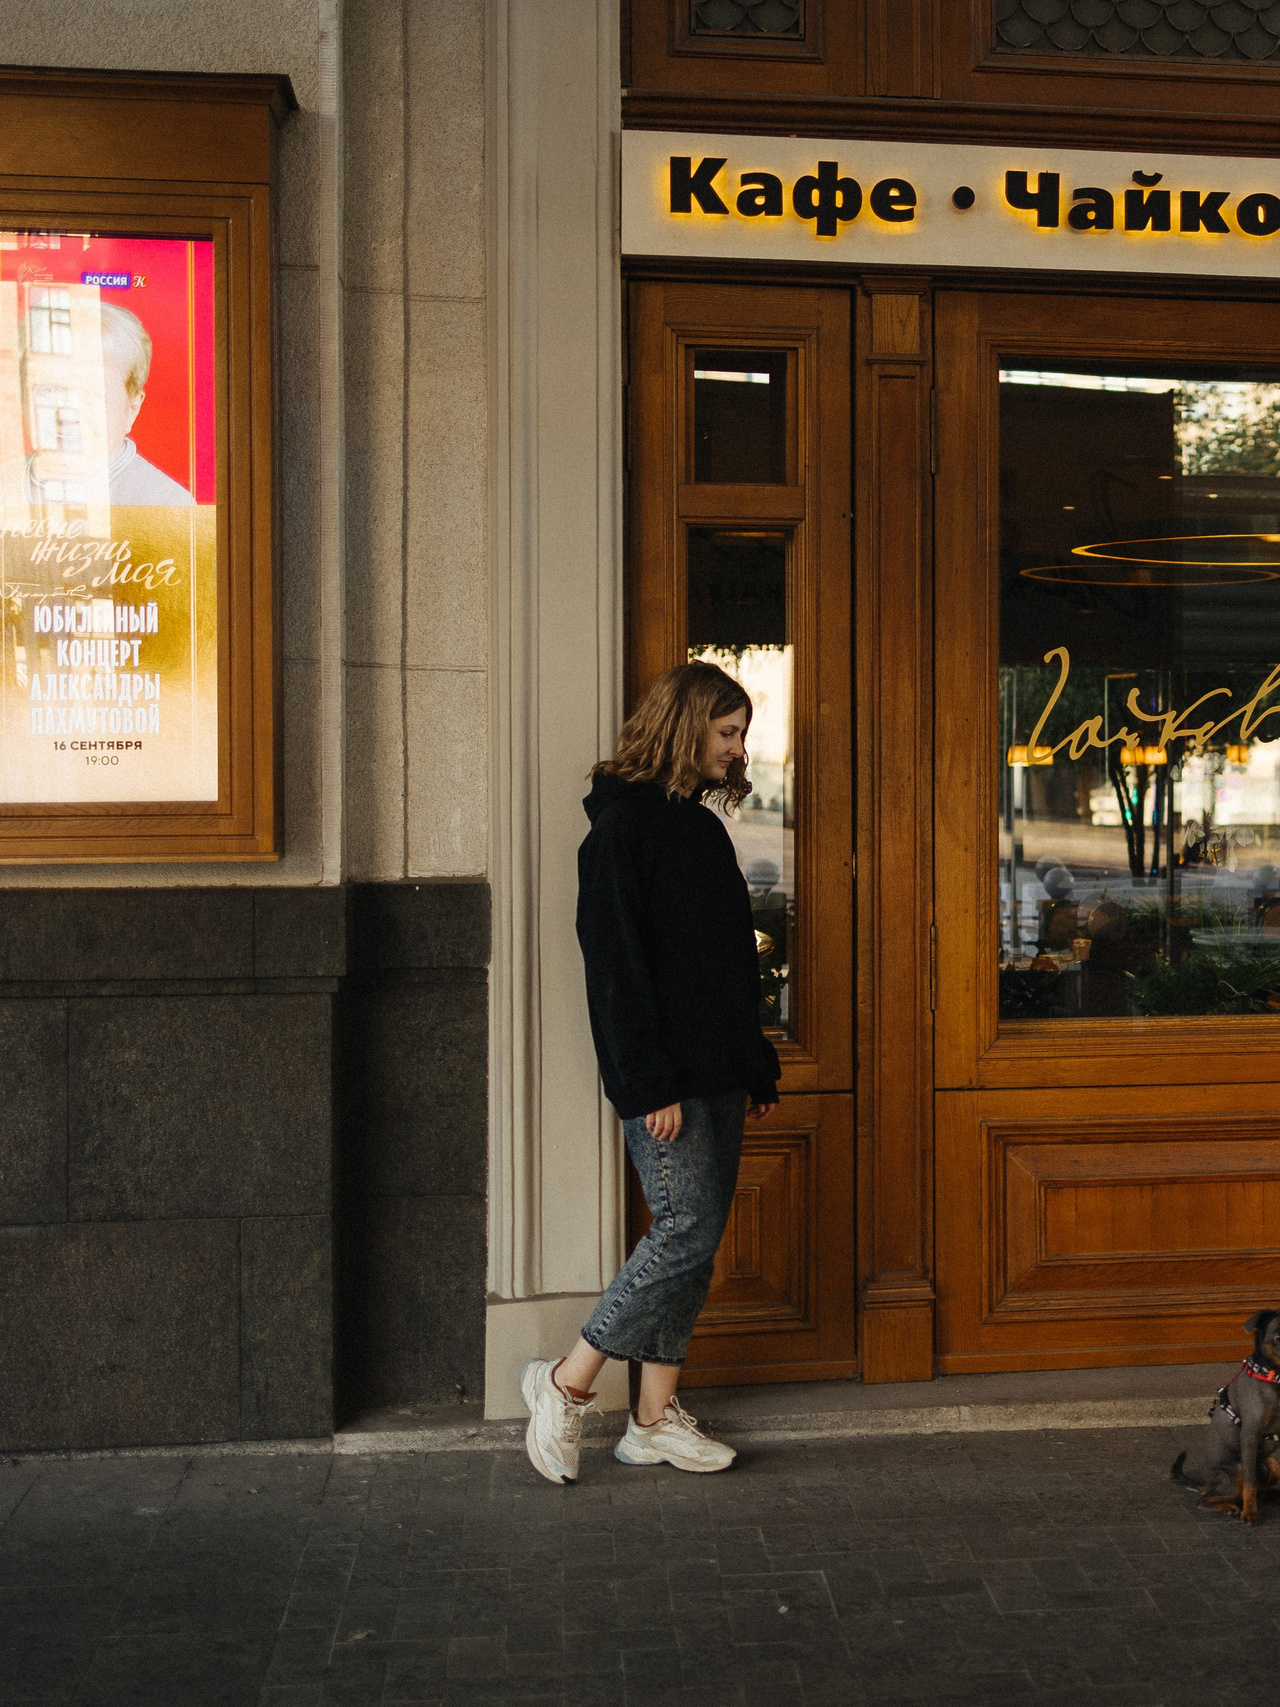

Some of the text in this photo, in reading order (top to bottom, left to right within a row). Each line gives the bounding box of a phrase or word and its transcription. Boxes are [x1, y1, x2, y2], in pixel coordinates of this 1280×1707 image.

[670, 157, 917, 236] Кафе
[85, 275, 127, 286] РОССИЯ
[33, 602, 159, 633] ЮБИЛЕЙНЫЙ
[57, 639, 142, 673] КОНЦЕРТ
[30, 673, 160, 707] АЛЕКСАНДРЫ
[30, 704, 160, 734] ПАХМУТОВОЙ
[53, 741, 143, 751] 16 СЕНТЯБРЯ
[85, 756, 119, 766] 19:00
